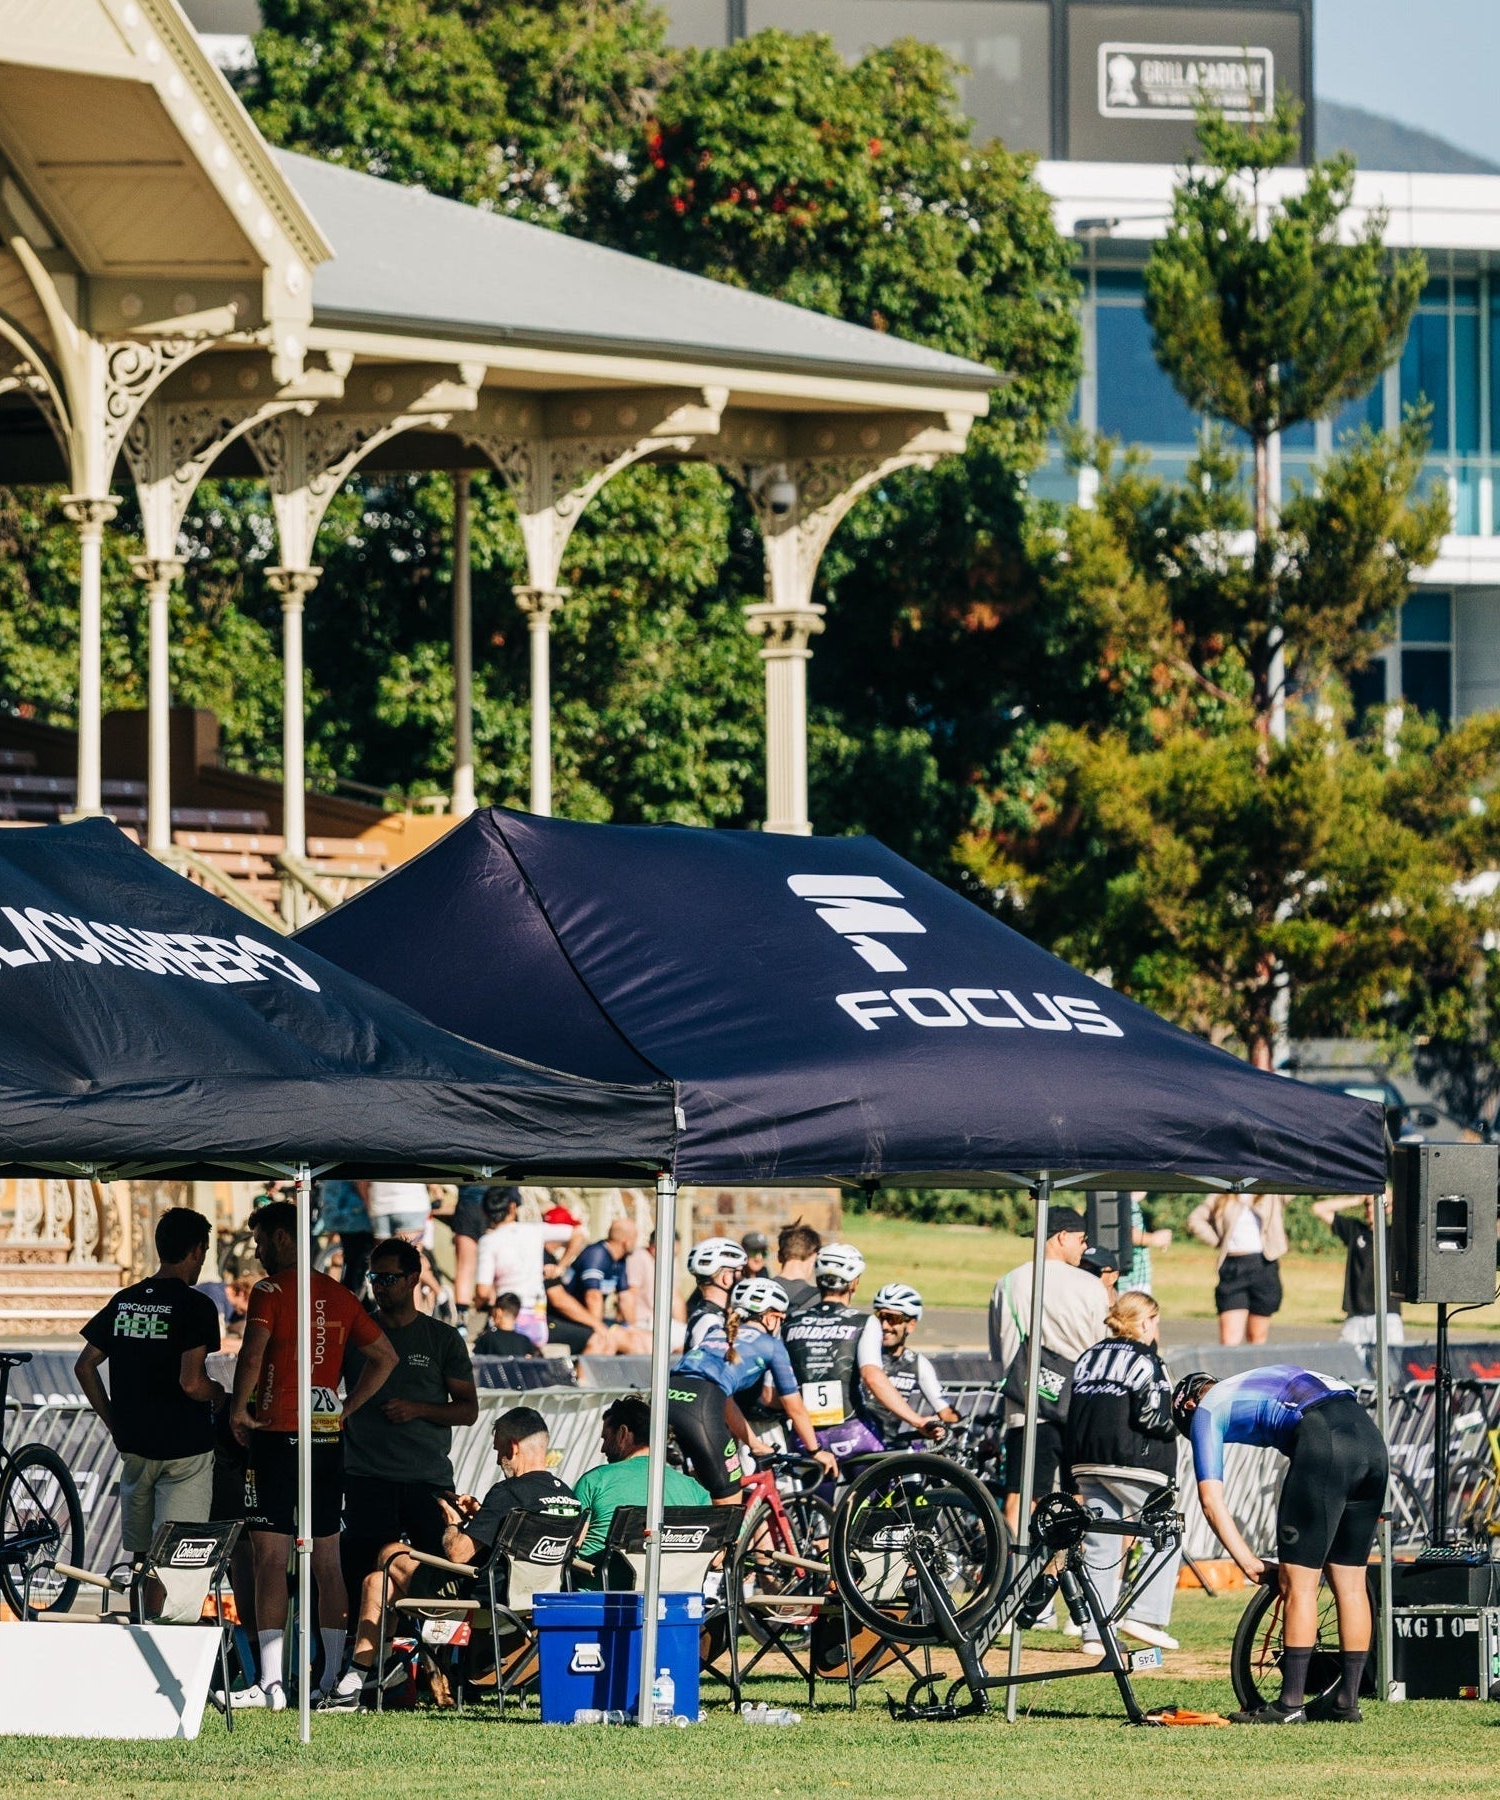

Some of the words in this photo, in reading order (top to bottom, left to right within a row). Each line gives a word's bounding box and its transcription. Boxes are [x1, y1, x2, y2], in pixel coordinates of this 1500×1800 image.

[89, 921, 270, 984] SHEEP
[835, 988, 1125, 1038] FOCUS
[117, 1302, 173, 1314] TRACKHOUSE
[786, 1324, 858, 1342] HOLDFAST
[668, 1388, 698, 1402] OCC
[817, 1385, 829, 1407] 5
[974, 1545, 1049, 1660] MERIDA
